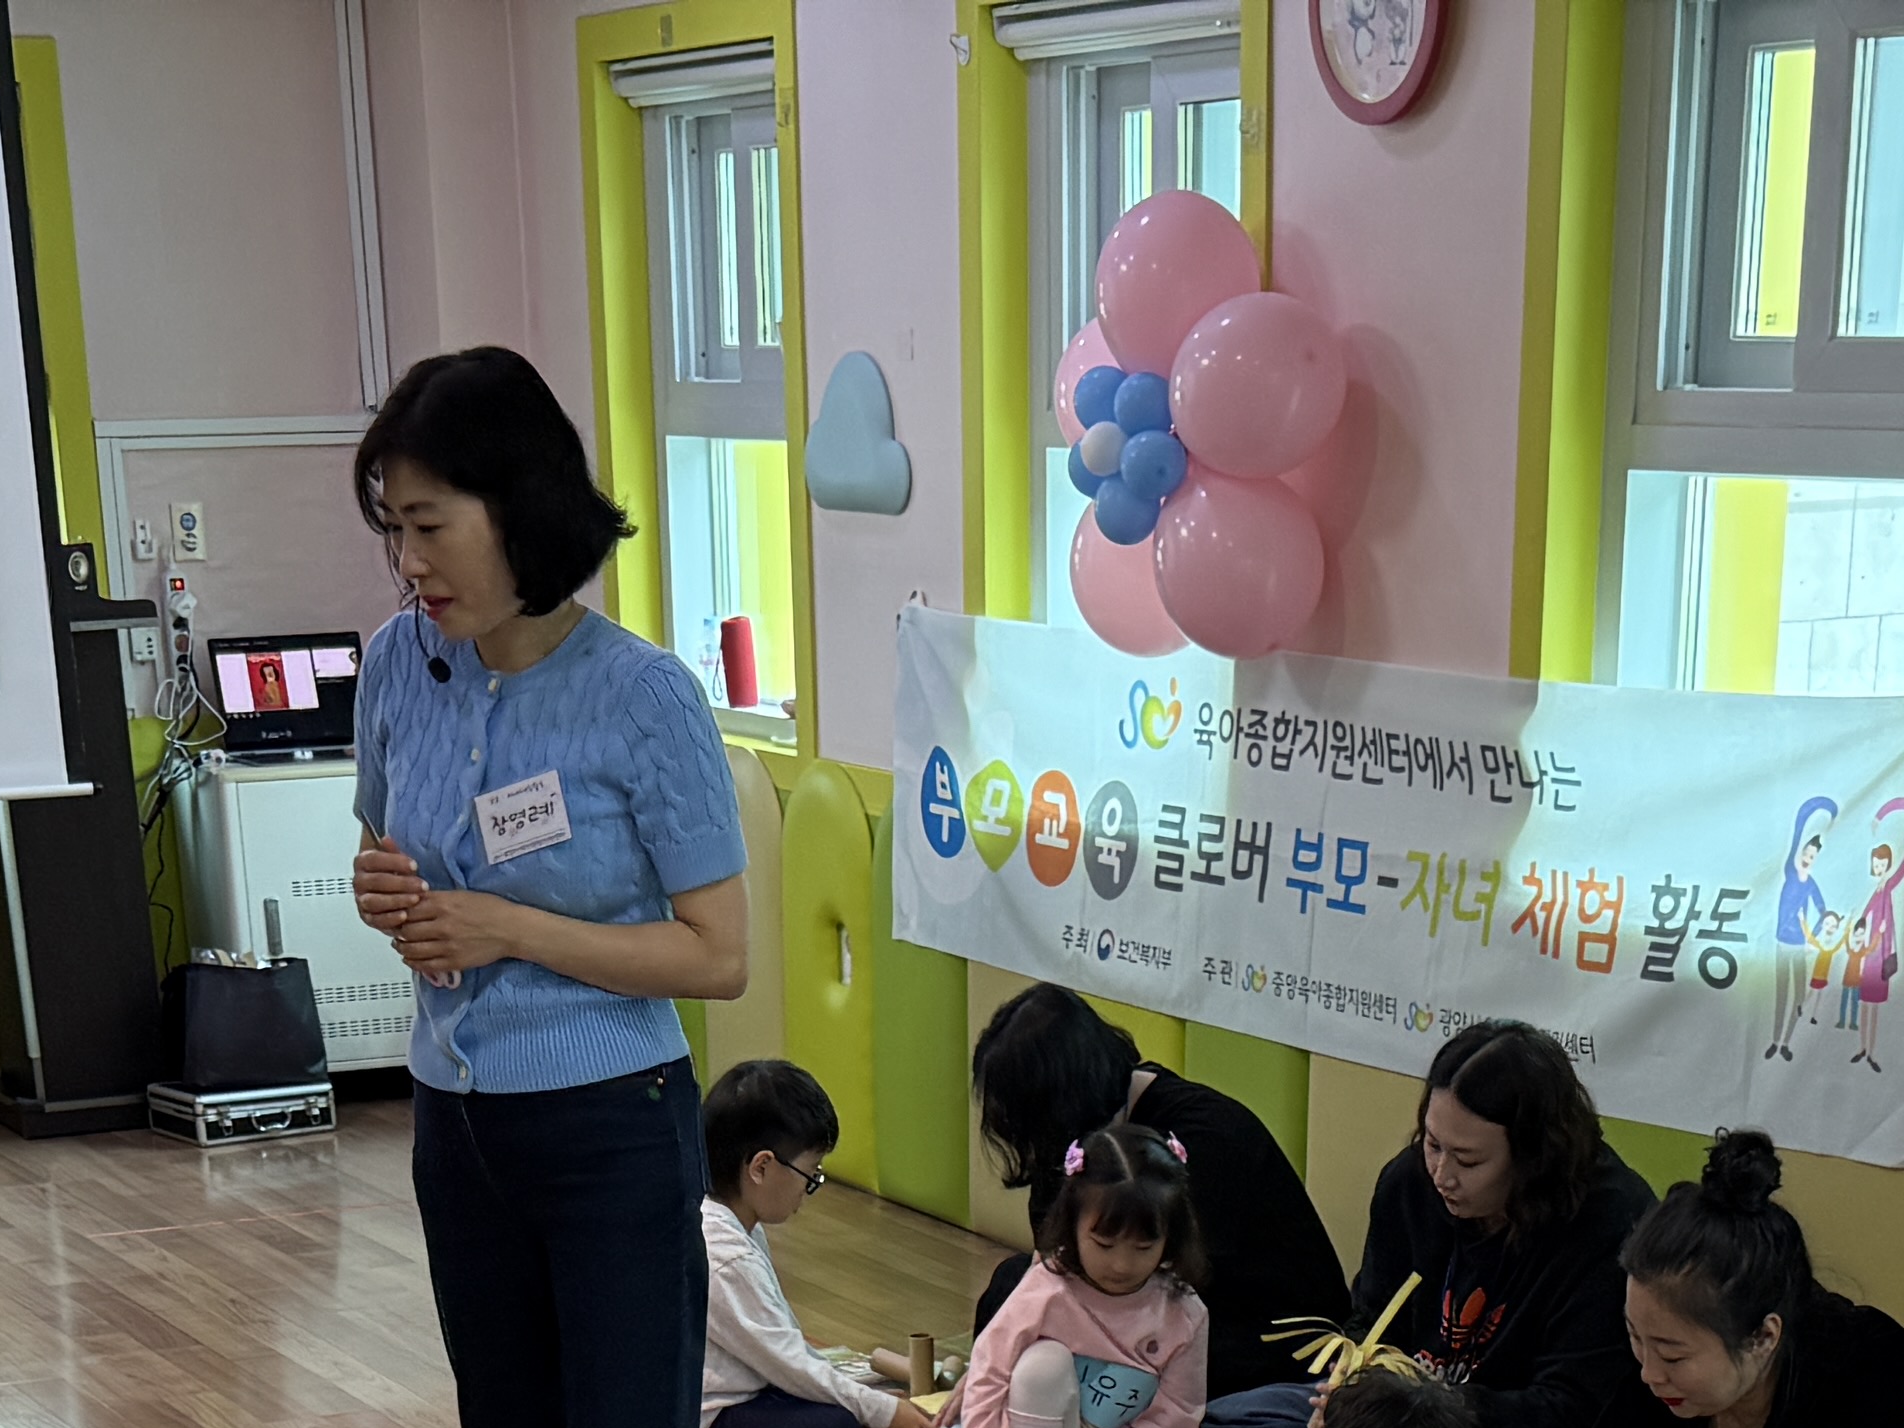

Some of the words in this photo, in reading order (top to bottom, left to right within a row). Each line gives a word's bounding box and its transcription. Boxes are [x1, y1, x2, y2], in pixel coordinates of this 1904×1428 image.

[1194, 701, 1474, 795] 육아종합지원센터에서
[1481, 743, 1582, 812] 만나는
[929, 760, 1127, 884] 부모교육
[1154, 803, 1273, 903] 클로버
[1511, 861, 1625, 974] 체험
[1640, 873, 1751, 990] 활동
[1116, 938, 1173, 970] 보건복지부
[1271, 970, 1398, 1025] 중앙육아종합지원센터
